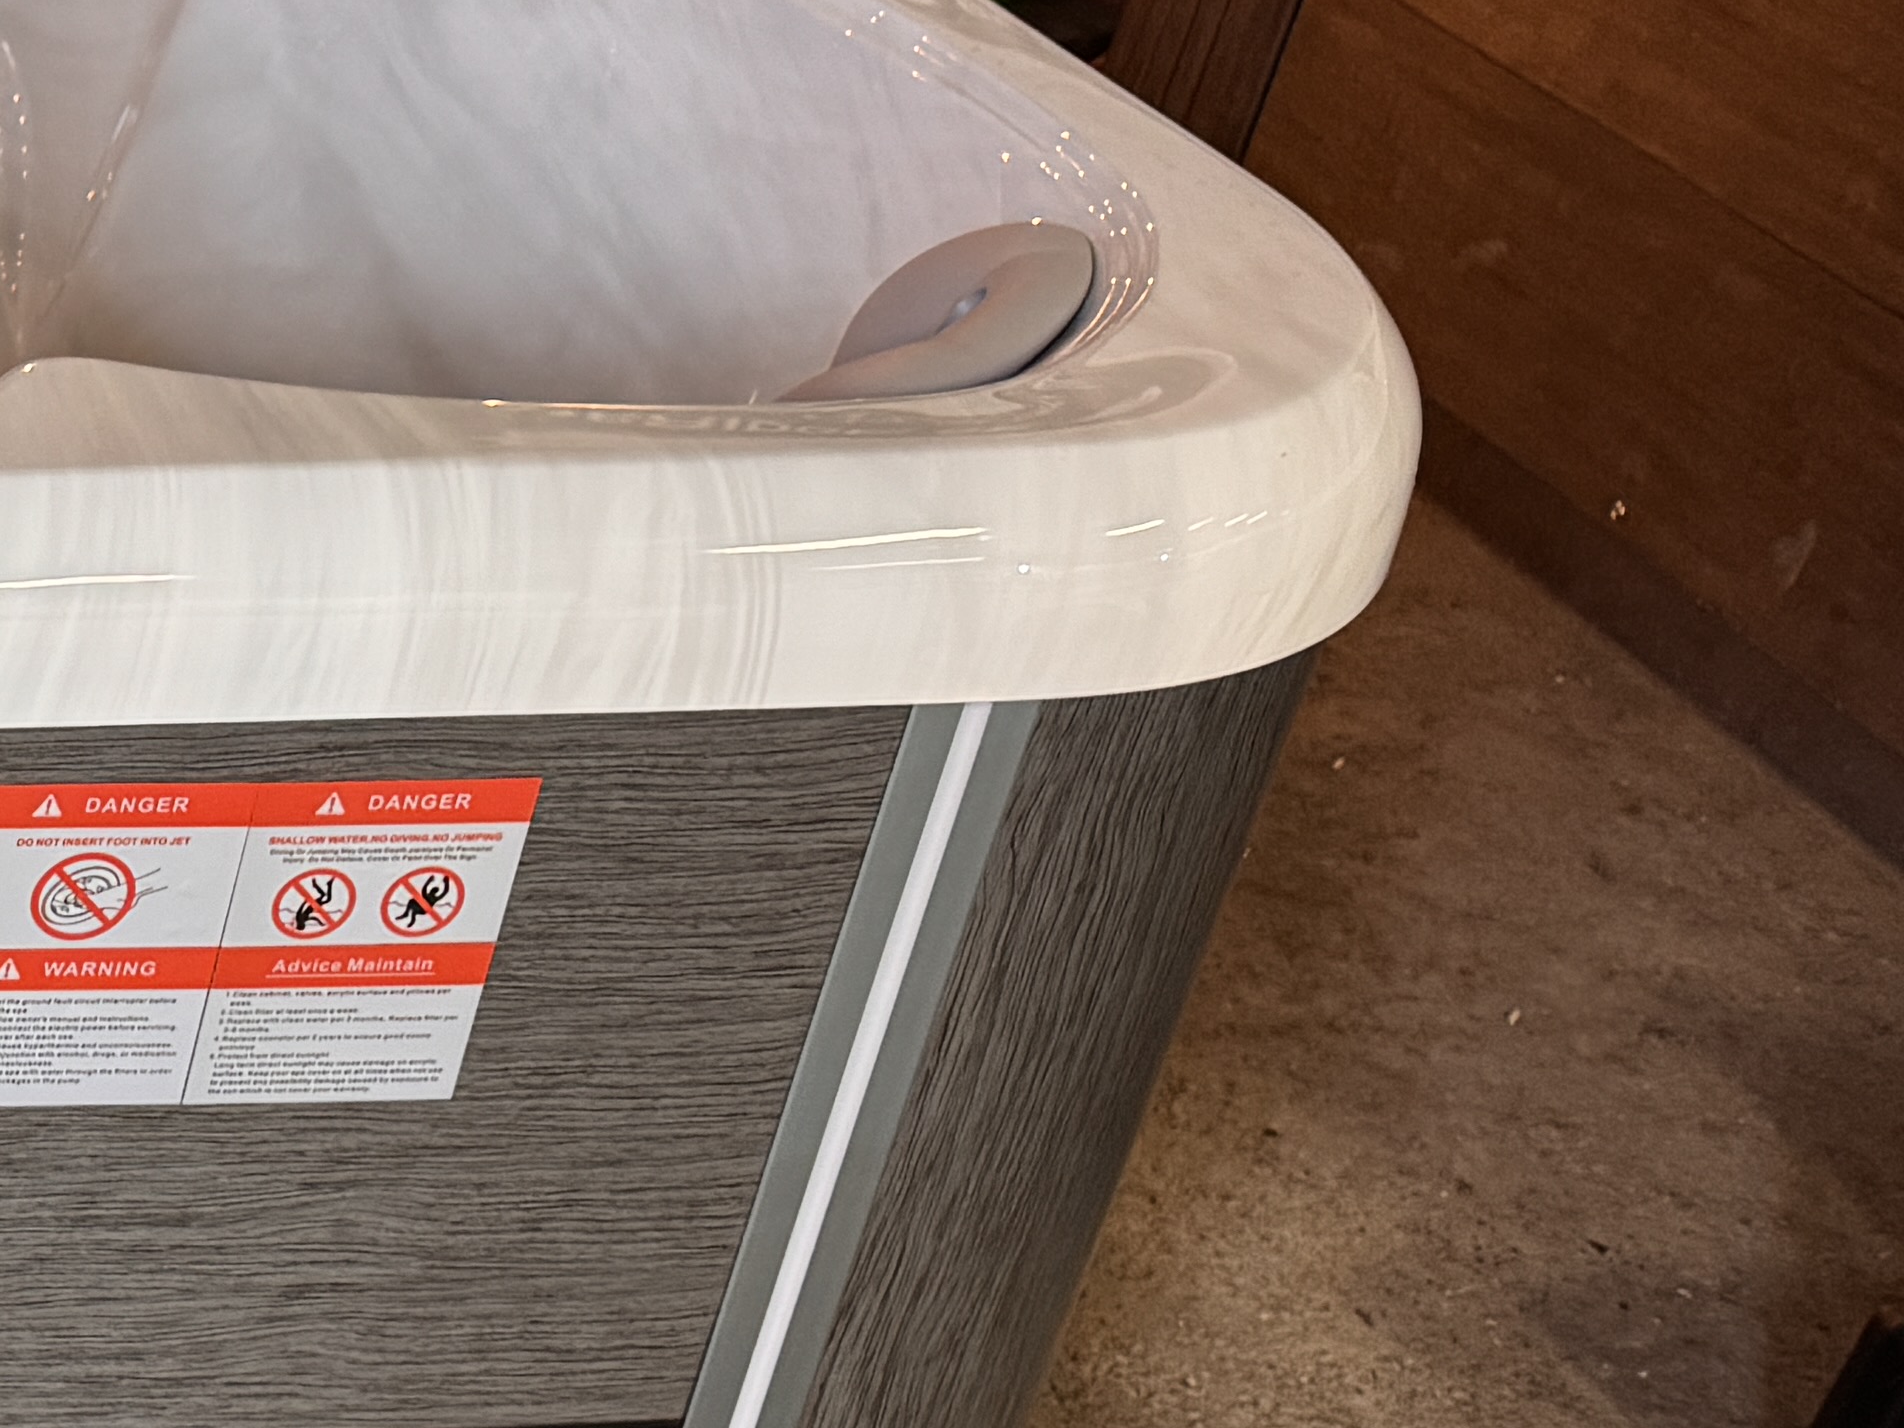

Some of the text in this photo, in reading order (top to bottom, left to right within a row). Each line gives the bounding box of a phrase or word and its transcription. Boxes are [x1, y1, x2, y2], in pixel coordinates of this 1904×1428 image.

[85, 797, 190, 813] DANGER
[368, 794, 472, 811] DANGER
[16, 836, 190, 847] DO NOT INSERT FOOT INTO JET
[269, 836, 326, 845] SHALLOW
[452, 832, 503, 842] JUMPING
[43, 960, 157, 977] WARNING
[272, 957, 434, 973] Advice Maintain
